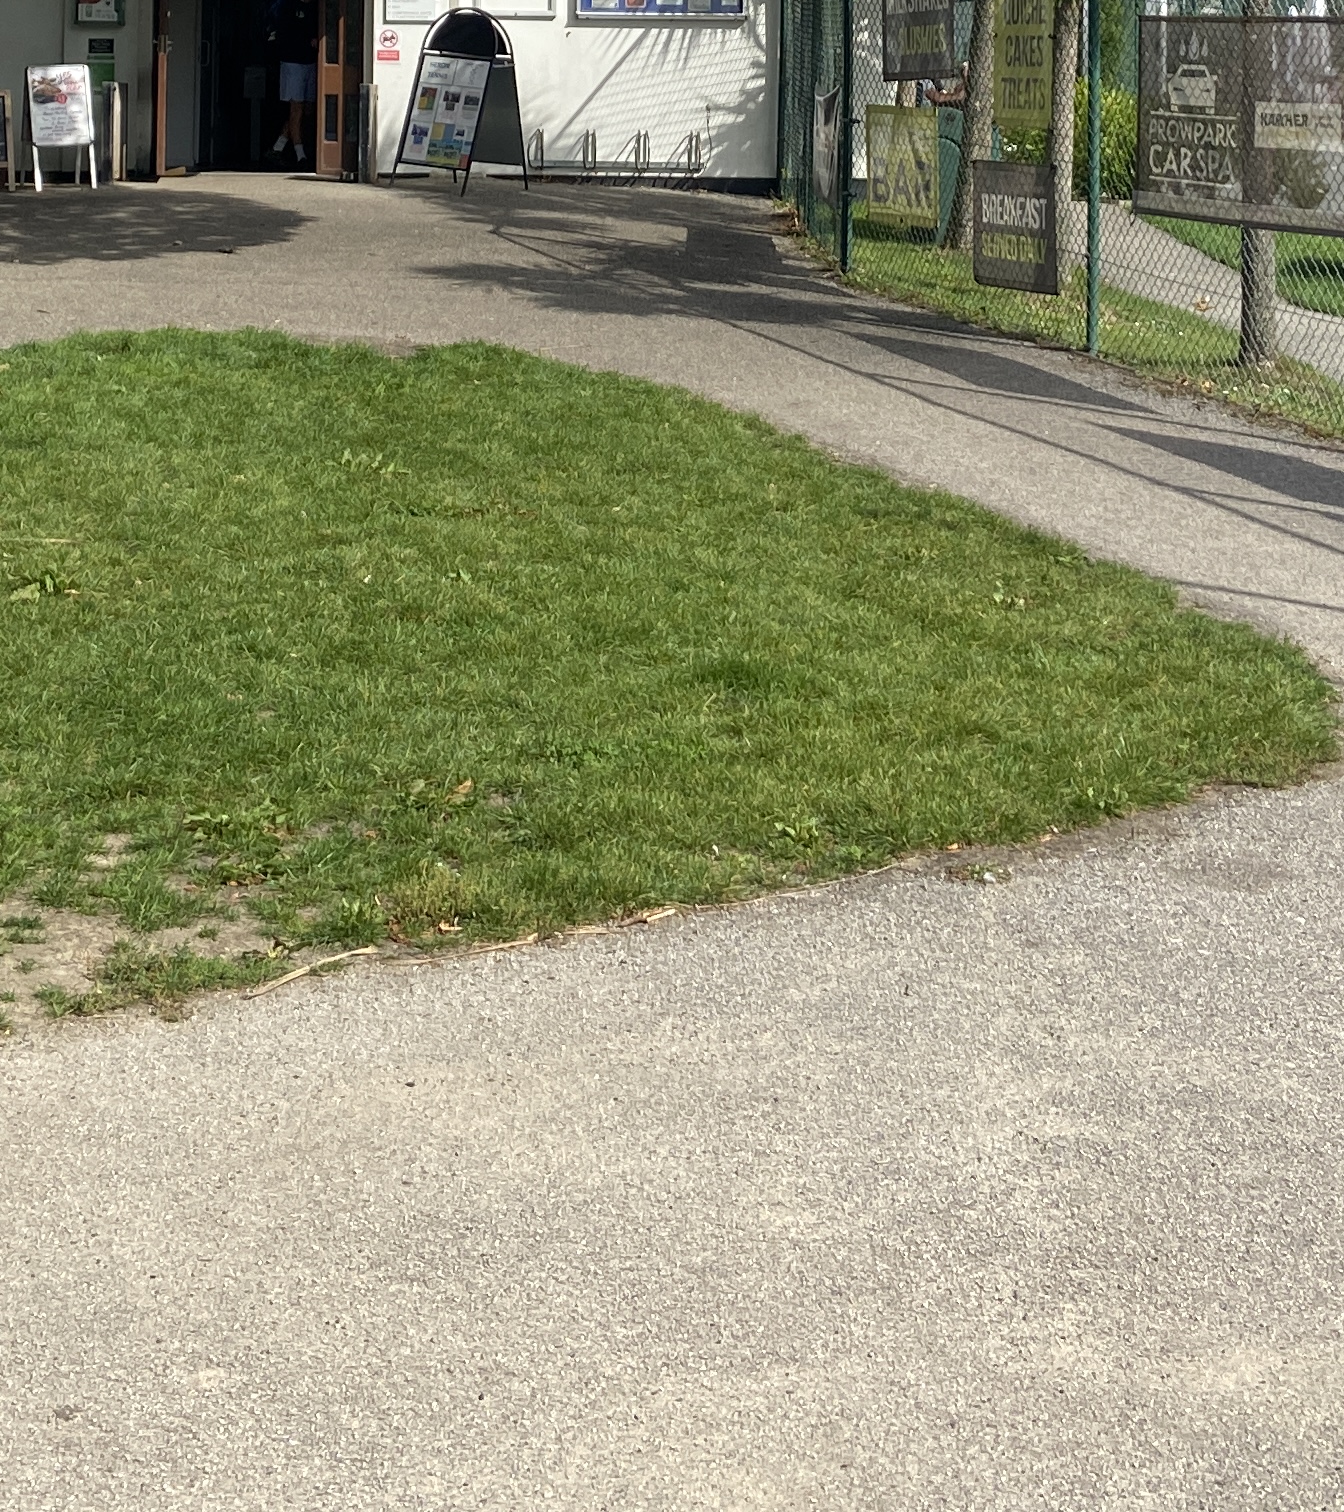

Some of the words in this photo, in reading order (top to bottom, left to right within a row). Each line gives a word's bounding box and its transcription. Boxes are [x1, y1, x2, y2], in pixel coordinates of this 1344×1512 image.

[1005, 35, 1044, 68] CAKES
[1001, 77, 1046, 110] TREATS
[981, 193, 1048, 229] BREAKFAST
